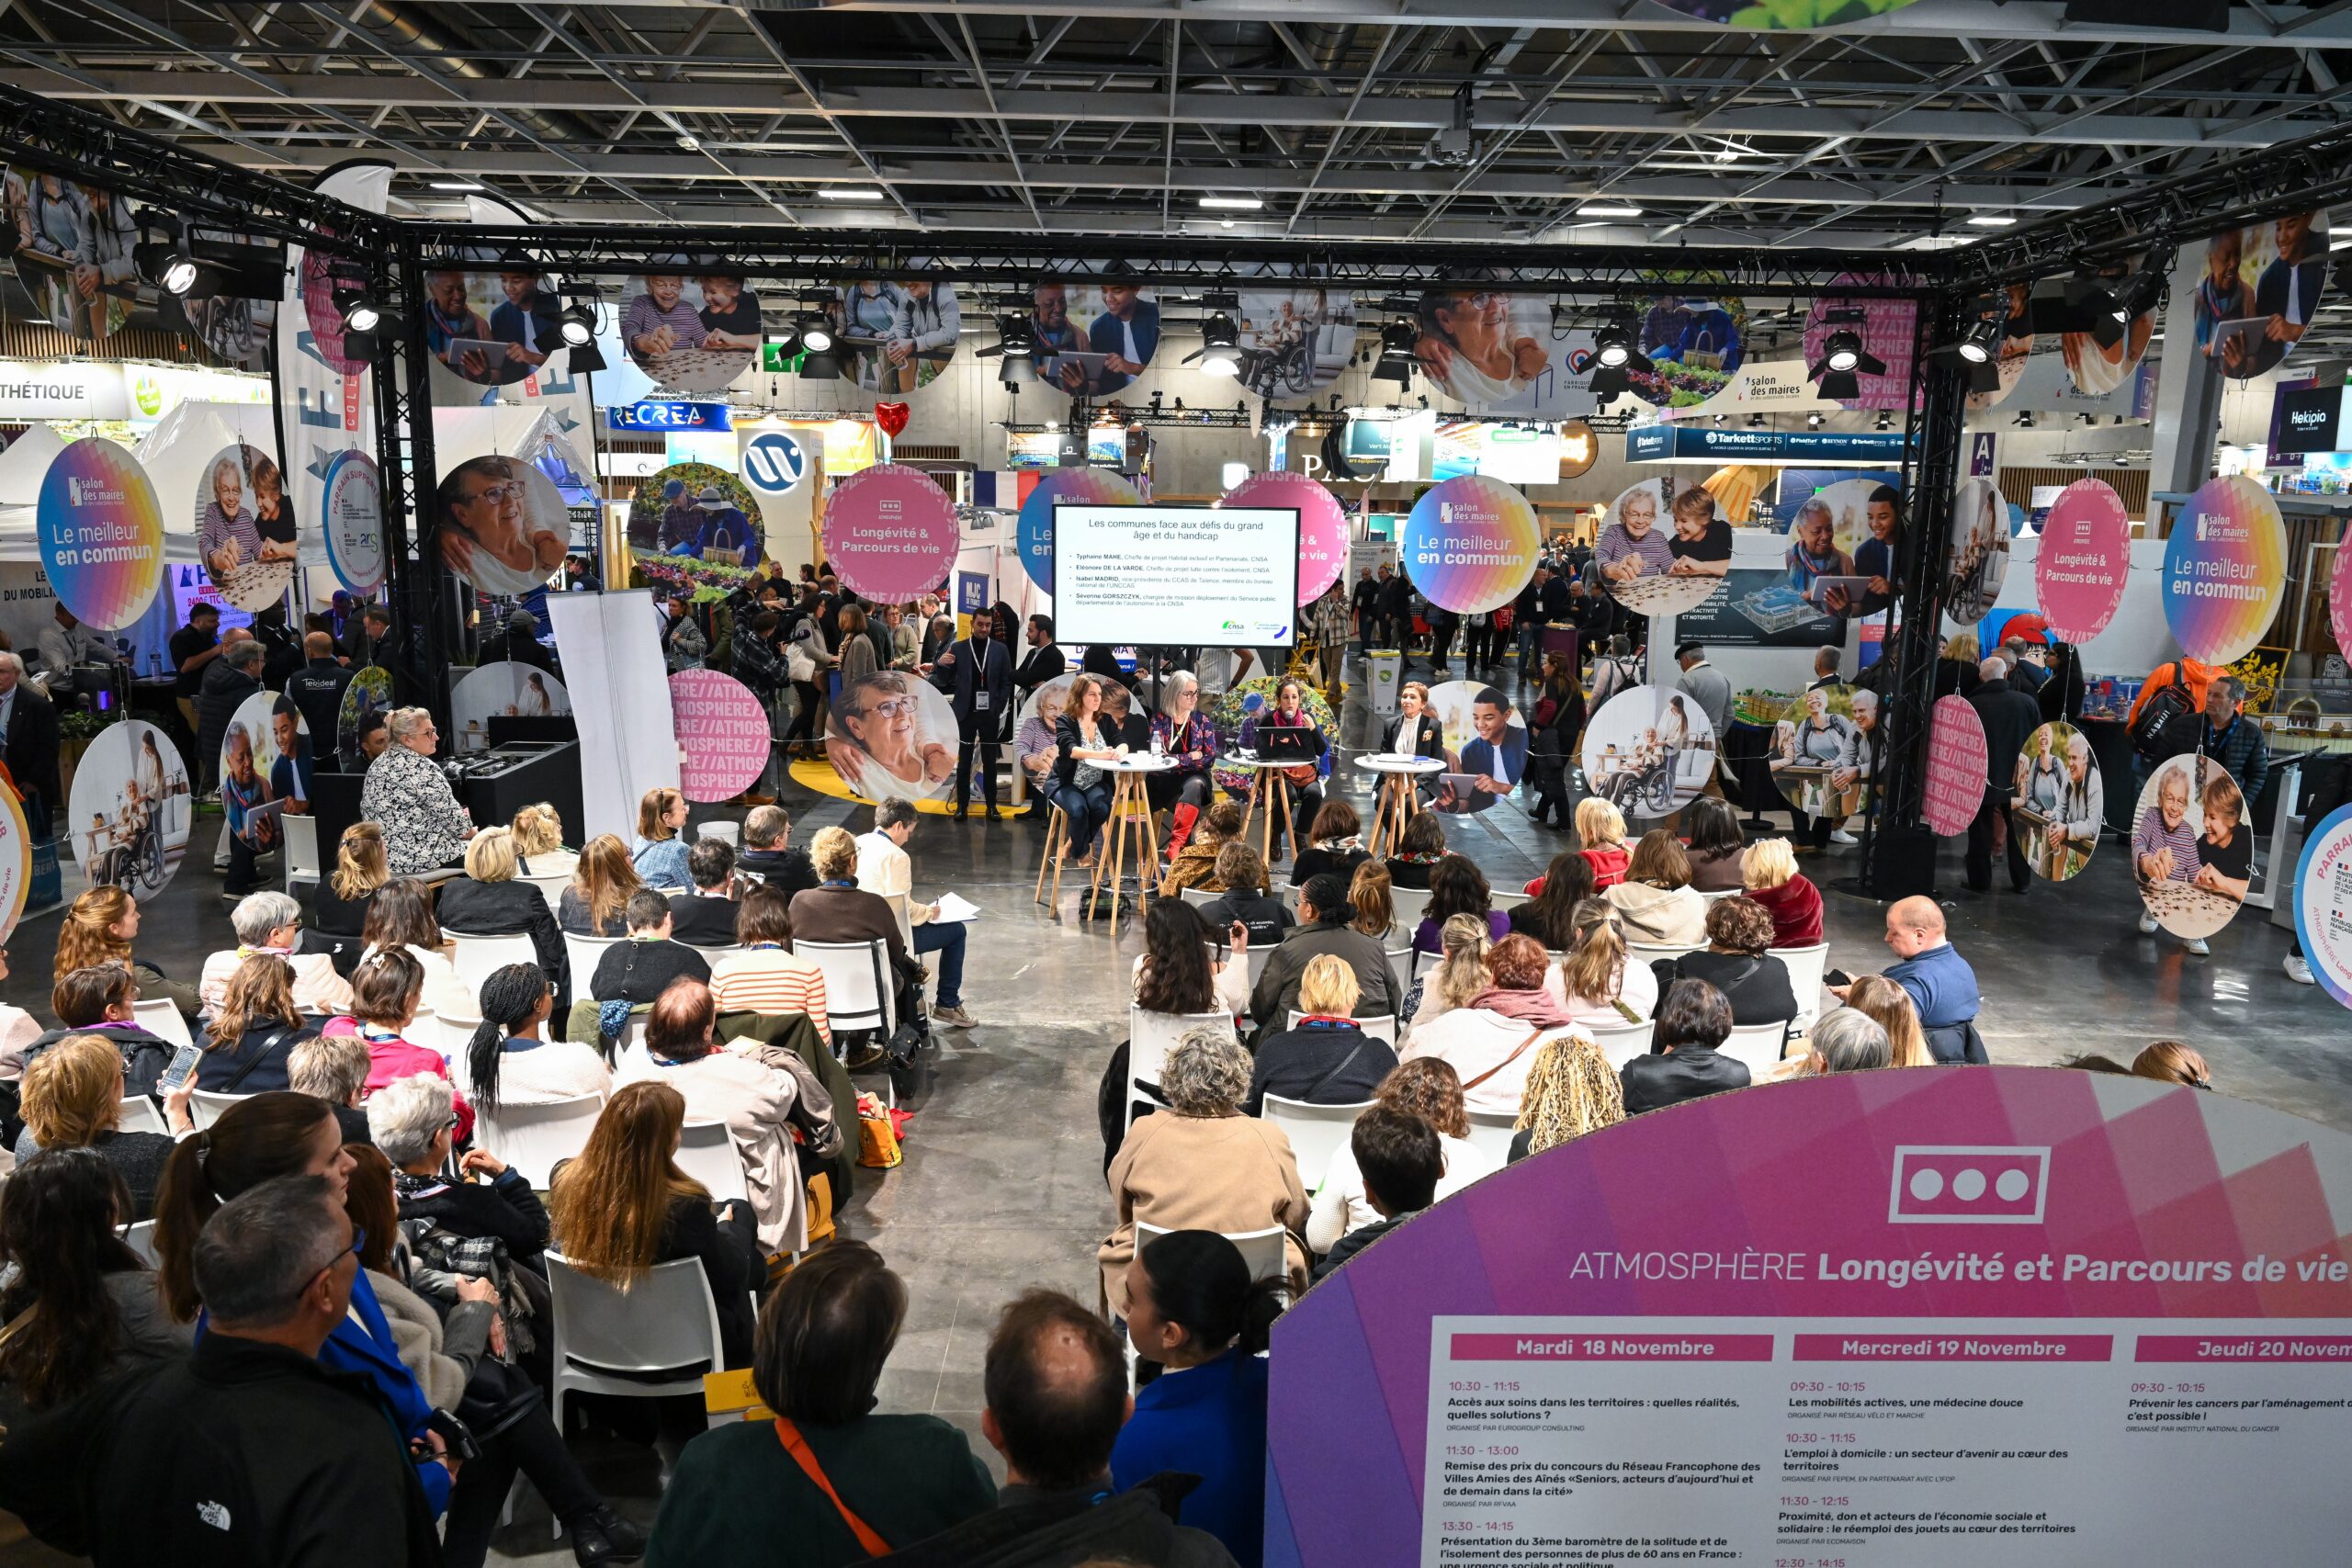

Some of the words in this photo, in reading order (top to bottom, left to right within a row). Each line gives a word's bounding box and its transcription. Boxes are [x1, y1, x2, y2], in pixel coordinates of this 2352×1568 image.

[1751, 376, 1776, 386] salon
[1751, 386, 1766, 396] des
[1769, 384, 1800, 395] maires
[2291, 409, 2326, 427] Hekipia
[1975, 435, 1990, 460] A
[81, 478, 103, 489] salon
[83, 490, 96, 501] des
[99, 489, 125, 501] maires
[1067, 494, 1091, 504] salon
[1453, 502, 1478, 512] salon
[1453, 511, 1469, 520] des
[1471, 513, 1500, 521] maires
[2209, 513, 2230, 525] salon
[1089, 519, 1105, 528] Les
[1107, 520, 1157, 528] communes
[1159, 520, 1179, 529] face
[1200, 521, 1221, 530] défis
[1224, 521, 1235, 530] du
[1238, 522, 1263, 532] grand
[2208, 525, 2221, 536] des
[2222, 525, 2249, 537] maires
[52, 524, 74, 544] Le
[78, 522, 139, 543] meilleur
[853, 526, 916, 540] Longévité
[920, 528, 929, 539] &
[1033, 525, 1052, 541] Le
[1133, 531, 1150, 541] âge
[1178, 531, 1219, 542] handicap
[842, 541, 900, 553] Parcours
[903, 543, 919, 553] de
[922, 543, 940, 554] vie
[1419, 534, 1439, 549] Le
[1443, 535, 1511, 550] meilleur
[55, 549, 78, 566] en
[82, 544, 153, 563] commun
[1309, 549, 1329, 560] vie
[1417, 552, 1440, 564] en
[1444, 553, 1524, 566] commun
[2054, 552, 2098, 568] Longévité
[2098, 554, 2107, 567] &
[2175, 555, 2192, 575] Le
[2195, 558, 2257, 580] meilleur
[2046, 570, 2085, 583] Parcours
[2086, 571, 2098, 584] de
[2098, 572, 2113, 585] vie
[2172, 580, 2191, 595] en
[2194, 581, 2267, 603] commun
[1569, 1246, 1807, 1281] ATMOSPHÈRE
[1817, 1252, 2006, 1289] Longévité
[2014, 1253, 2053, 1281] et
[2063, 1254, 2233, 1282] Parcours
[2241, 1254, 2287, 1282] de
[2296, 1253, 2349, 1282] vie
[1516, 1339, 1573, 1355] Mardi
[1582, 1340, 1606, 1355] 18
[1611, 1339, 1714, 1356] Novembre
[1841, 1339, 1932, 1356] Mercredi
[1936, 1340, 1959, 1356] 19
[1962, 1340, 2067, 1356] Novembre
[2197, 1341, 2255, 1357] Jeudi
[2257, 1342, 2285, 1357] 20
[1449, 1382, 1481, 1391] 10:30
[1493, 1382, 1521, 1391] 11:15
[1790, 1382, 1824, 1392] 09:30
[1837, 1382, 1866, 1392] 10:15
[2131, 1382, 2165, 1393] 09:30
[2176, 1382, 2206, 1393] 10:15
[1448, 1397, 1482, 1407] Accès
[1485, 1399, 1505, 1407] aux
[1508, 1397, 1537, 1407] soins
[1539, 1397, 1566, 1407] dans
[1569, 1397, 1586, 1407] les
[1588, 1397, 1645, 1407] territoires
[1652, 1398, 1692, 1409] quelles
[1694, 1397, 1740, 1408] réalités,
[1788, 1398, 1808, 1407] Les
[1810, 1397, 1861, 1407] mobilités
[1863, 1398, 1907, 1408] actives,
[1909, 1399, 1931, 1407] une
[1933, 1397, 1987, 1407] médecine
[1989, 1398, 2024, 1407] douce
[2129, 1398, 2176, 1408] Prévenir
[2177, 1399, 2193, 1408] les
[2241, 1401, 2260, 1410] par
[2261, 1398, 2346, 1410] l'aménagement
[1447, 1410, 1487, 1421] quelles
[1489, 1410, 1542, 1420] solutions
[1544, 1410, 1551, 1419] ?
[1838, 1411, 1866, 1419] RÉSEAU
[2127, 1411, 2154, 1421] c'est
[2155, 1412, 2201, 1422] possible
